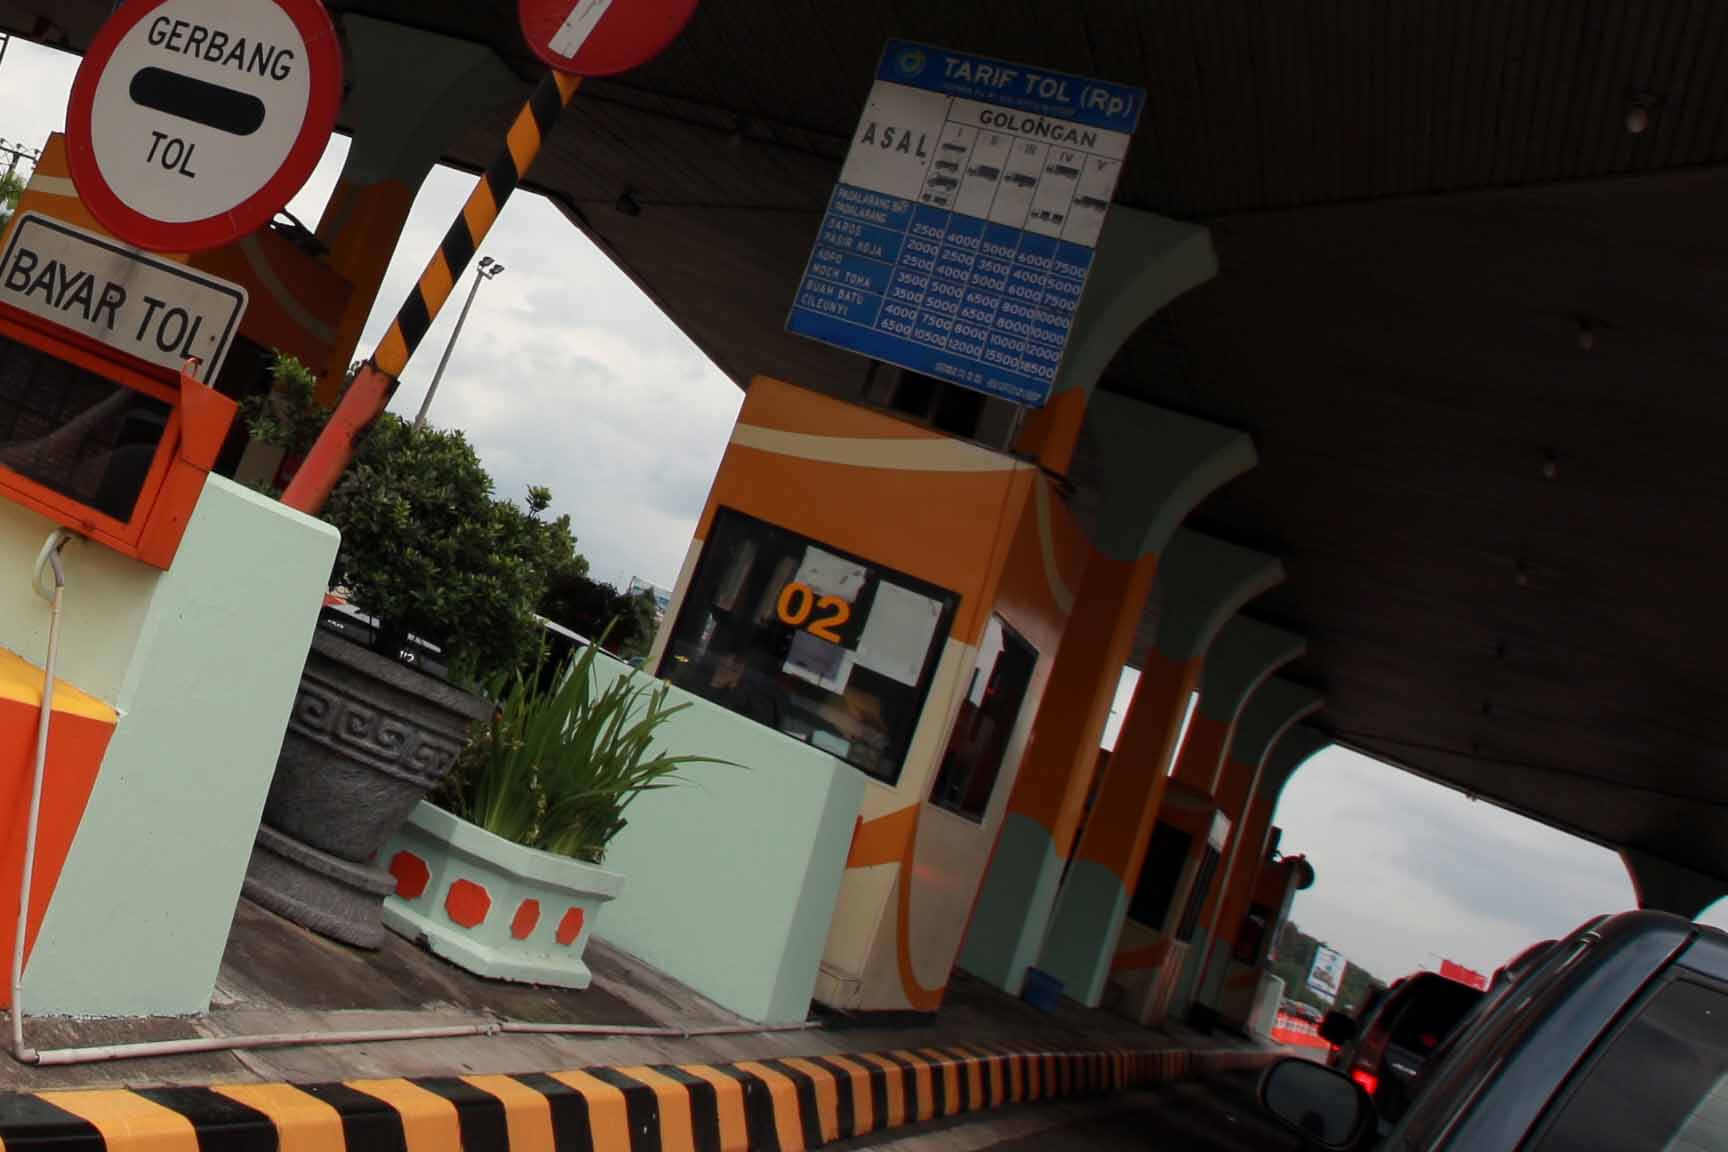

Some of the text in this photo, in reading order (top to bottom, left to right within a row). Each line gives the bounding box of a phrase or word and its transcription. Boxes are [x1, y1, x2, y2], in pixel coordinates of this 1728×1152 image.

[148, 16, 294, 81] GERBANG
[943, 56, 1017, 88] TARIF
[1025, 75, 1073, 102] TOL
[1079, 85, 1134, 119] (Rp)
[860, 121, 927, 158] ASAL
[979, 109, 1096, 148] GOLONGAN
[145, 131, 197, 178] TOL
[907, 240, 938, 256] 2000
[913, 223, 944, 240] 2500
[4, 250, 207, 363] BAYAR TOL
[885, 303, 917, 321] 4000
[954, 323, 987, 340] 8000
[880, 319, 912, 337] 6500
[777, 583, 851, 644] 02
